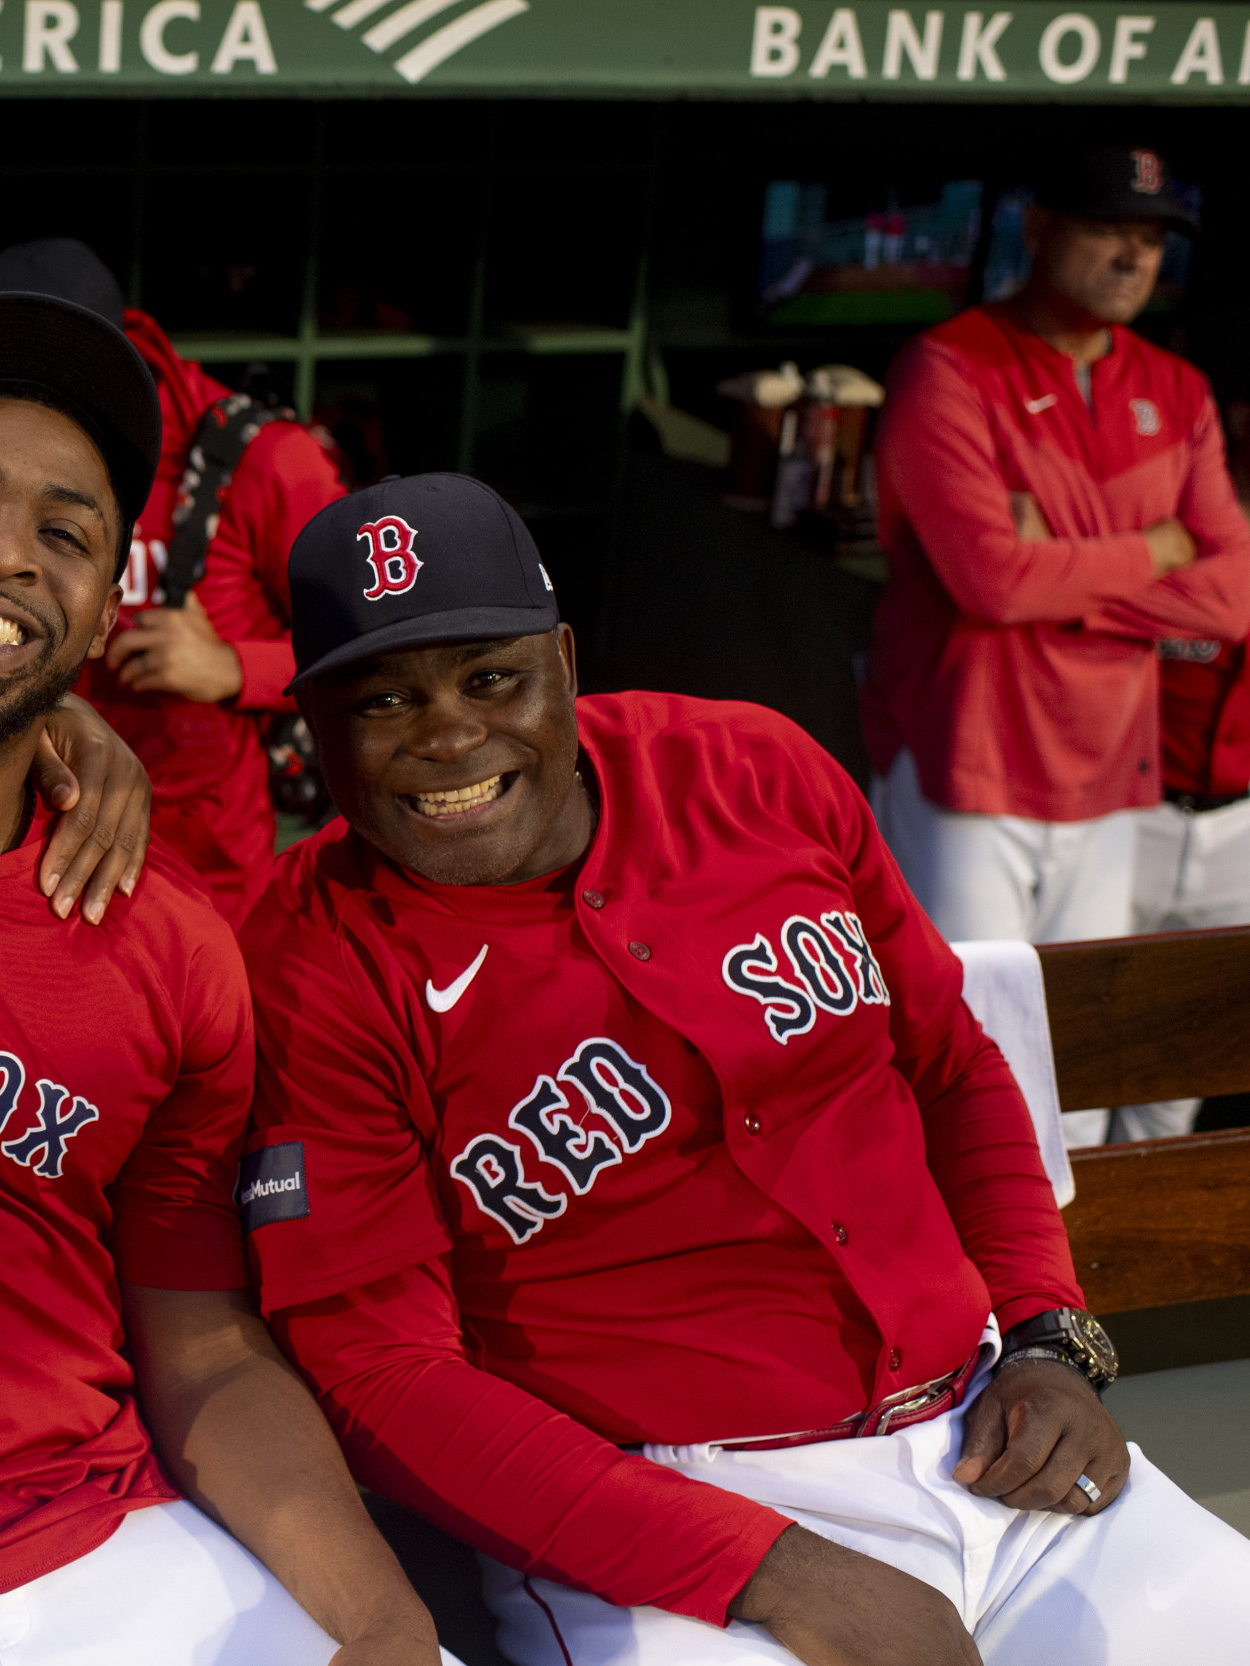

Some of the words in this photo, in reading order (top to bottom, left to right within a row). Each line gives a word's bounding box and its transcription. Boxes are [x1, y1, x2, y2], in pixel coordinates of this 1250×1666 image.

[750, 7, 1014, 81] BANK
[1038, 12, 1156, 85] OF
[1130, 150, 1162, 195] B
[356, 515, 425, 602] B
[450, 1036, 672, 1245] RED
[722, 911, 891, 1045] SOX
